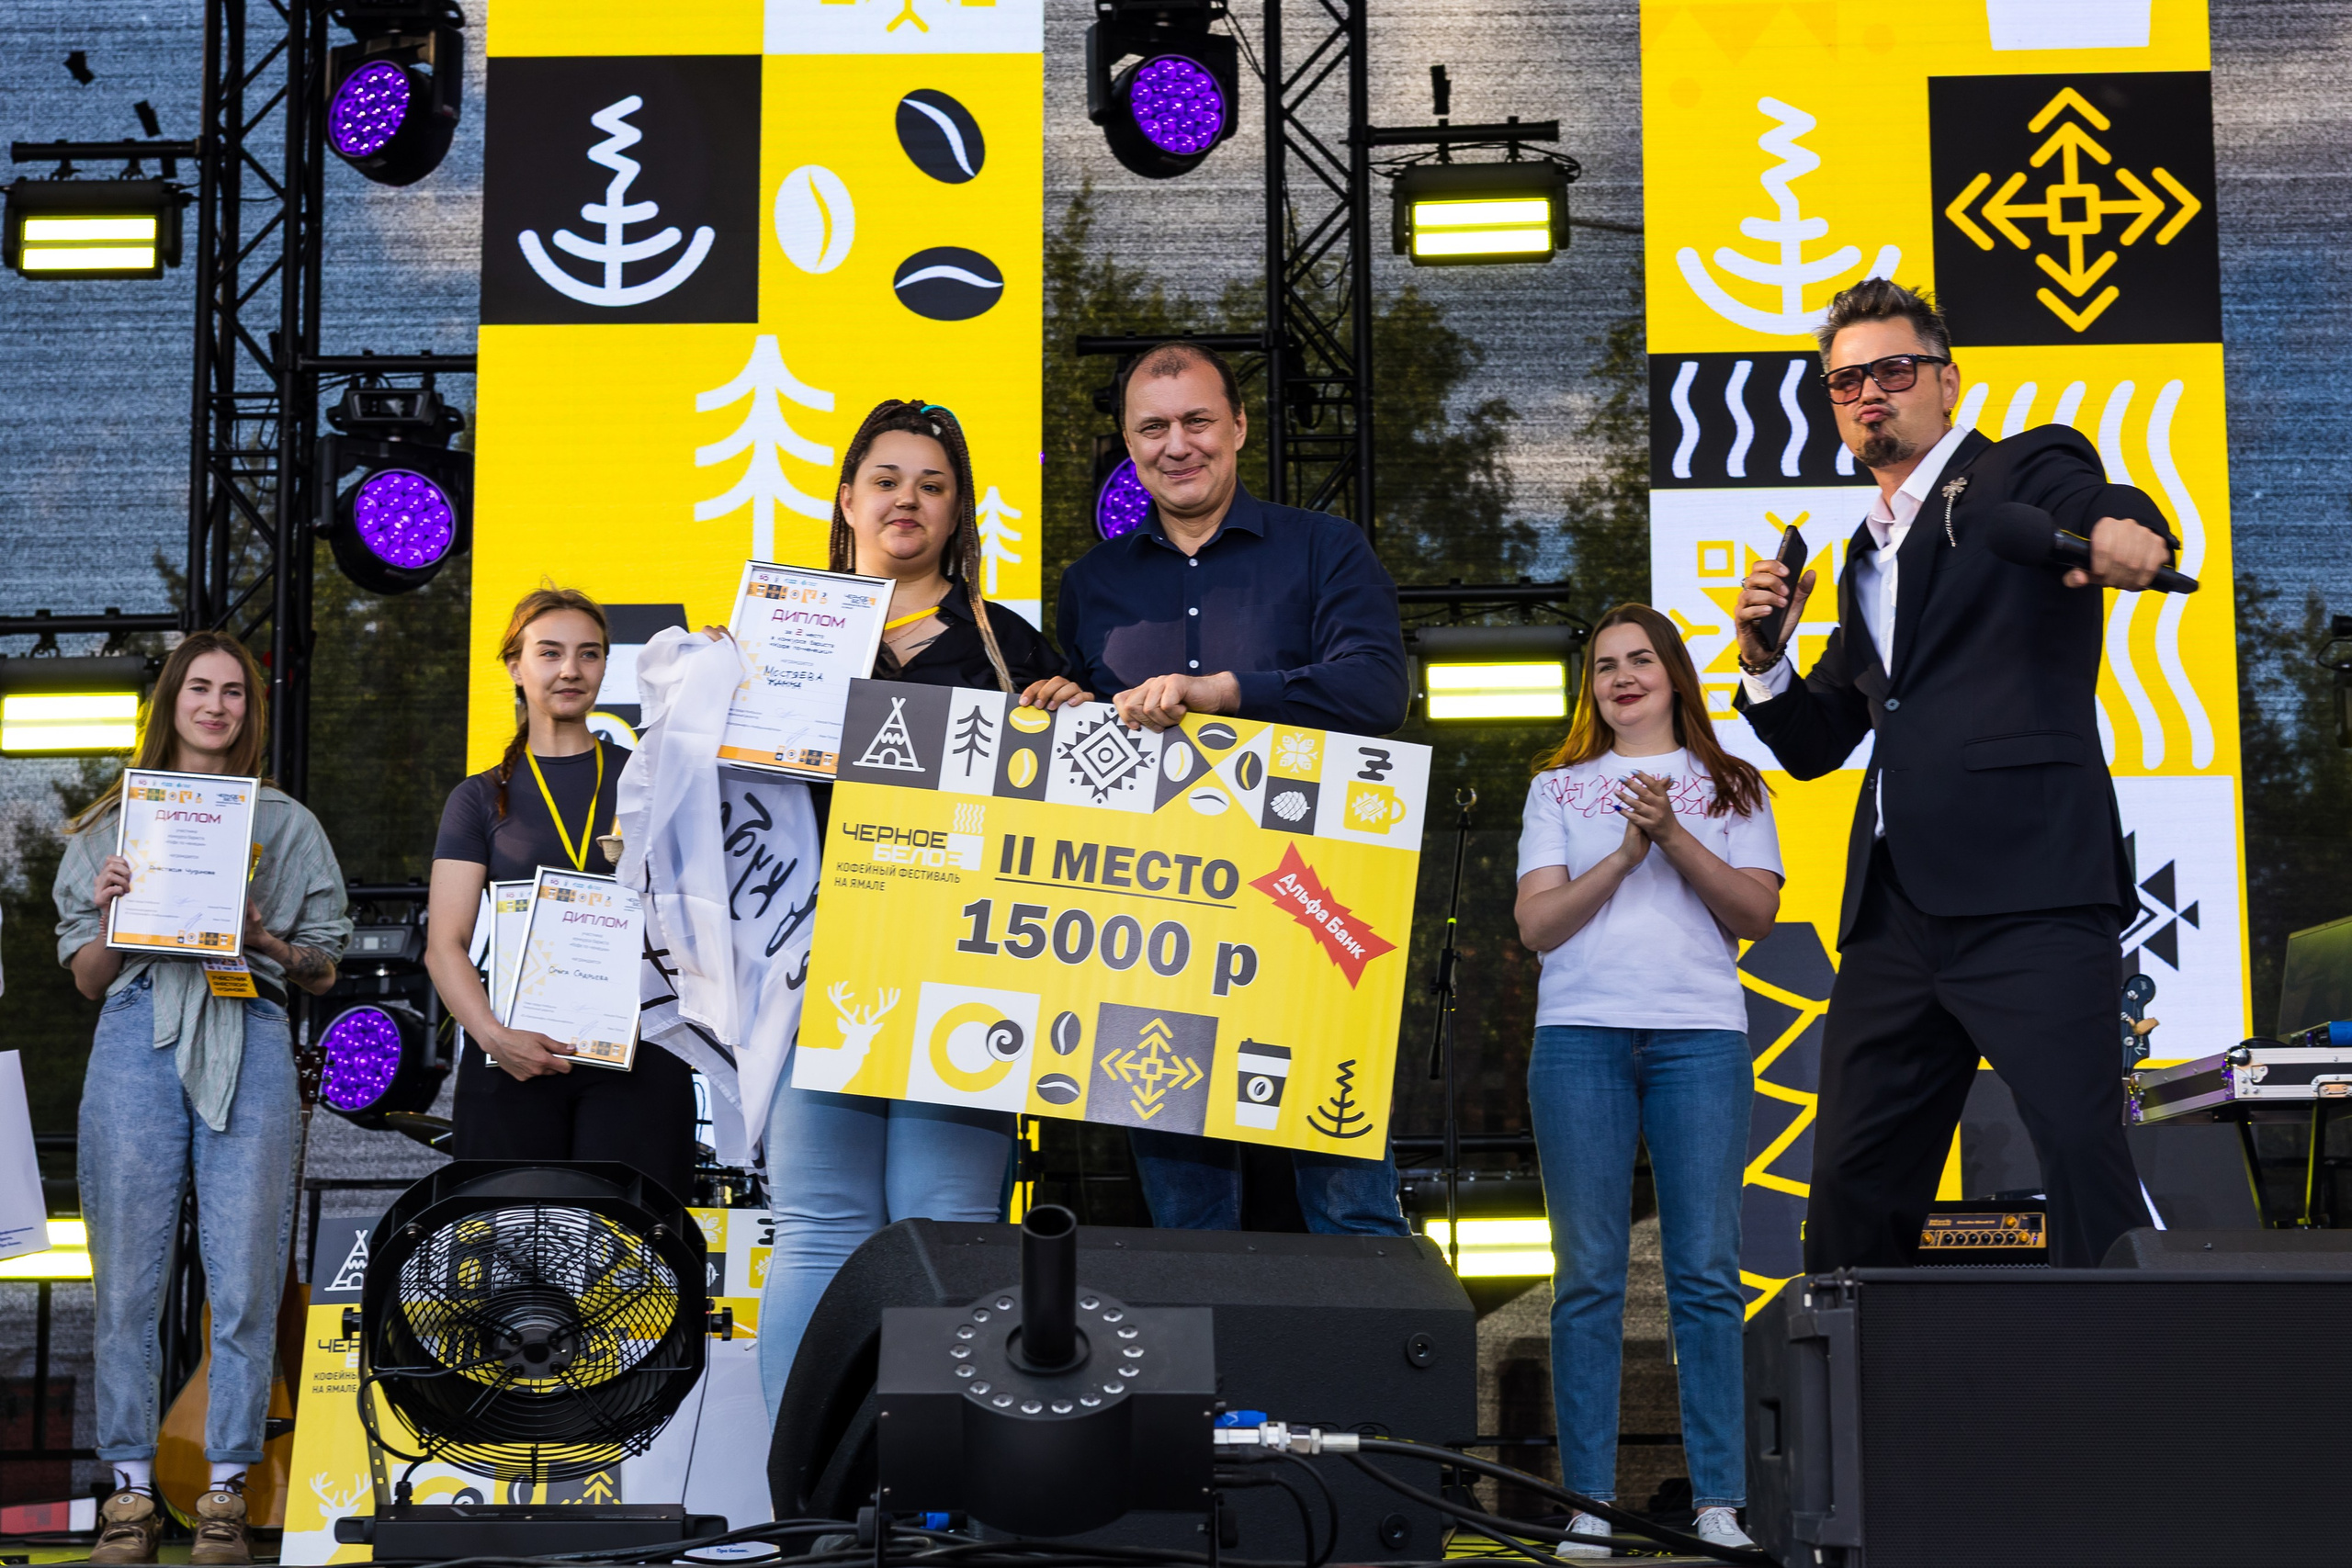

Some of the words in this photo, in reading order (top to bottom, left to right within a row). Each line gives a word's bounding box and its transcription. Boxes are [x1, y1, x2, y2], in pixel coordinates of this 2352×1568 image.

[772, 608, 846, 628] ДИПЛОМ
[155, 809, 221, 824] ДИПЛОМ
[842, 822, 948, 849] ЧЕРНОЕ
[872, 843, 965, 869] БЕЛОЕ
[836, 862, 897, 877] КОФЕЙНЫЙ
[899, 869, 961, 884] ФЕСТИВАЛЬ
[1051, 839, 1240, 900] МЕСТО
[834, 877, 848, 887] НА
[849, 878, 886, 892] ЯМАЛЕ
[562, 910, 628, 930] ДИПЛОМ
[1273, 873, 1329, 923] Альфа
[1325, 916, 1367, 960] Банк
[956, 897, 1192, 977] 15000
[318, 1338, 360, 1353] ЧЕР
[313, 1370, 359, 1381] КОФЕЙНЫ
[312, 1385, 324, 1393] НА
[326, 1384, 357, 1393] ЯМАЛЕ
